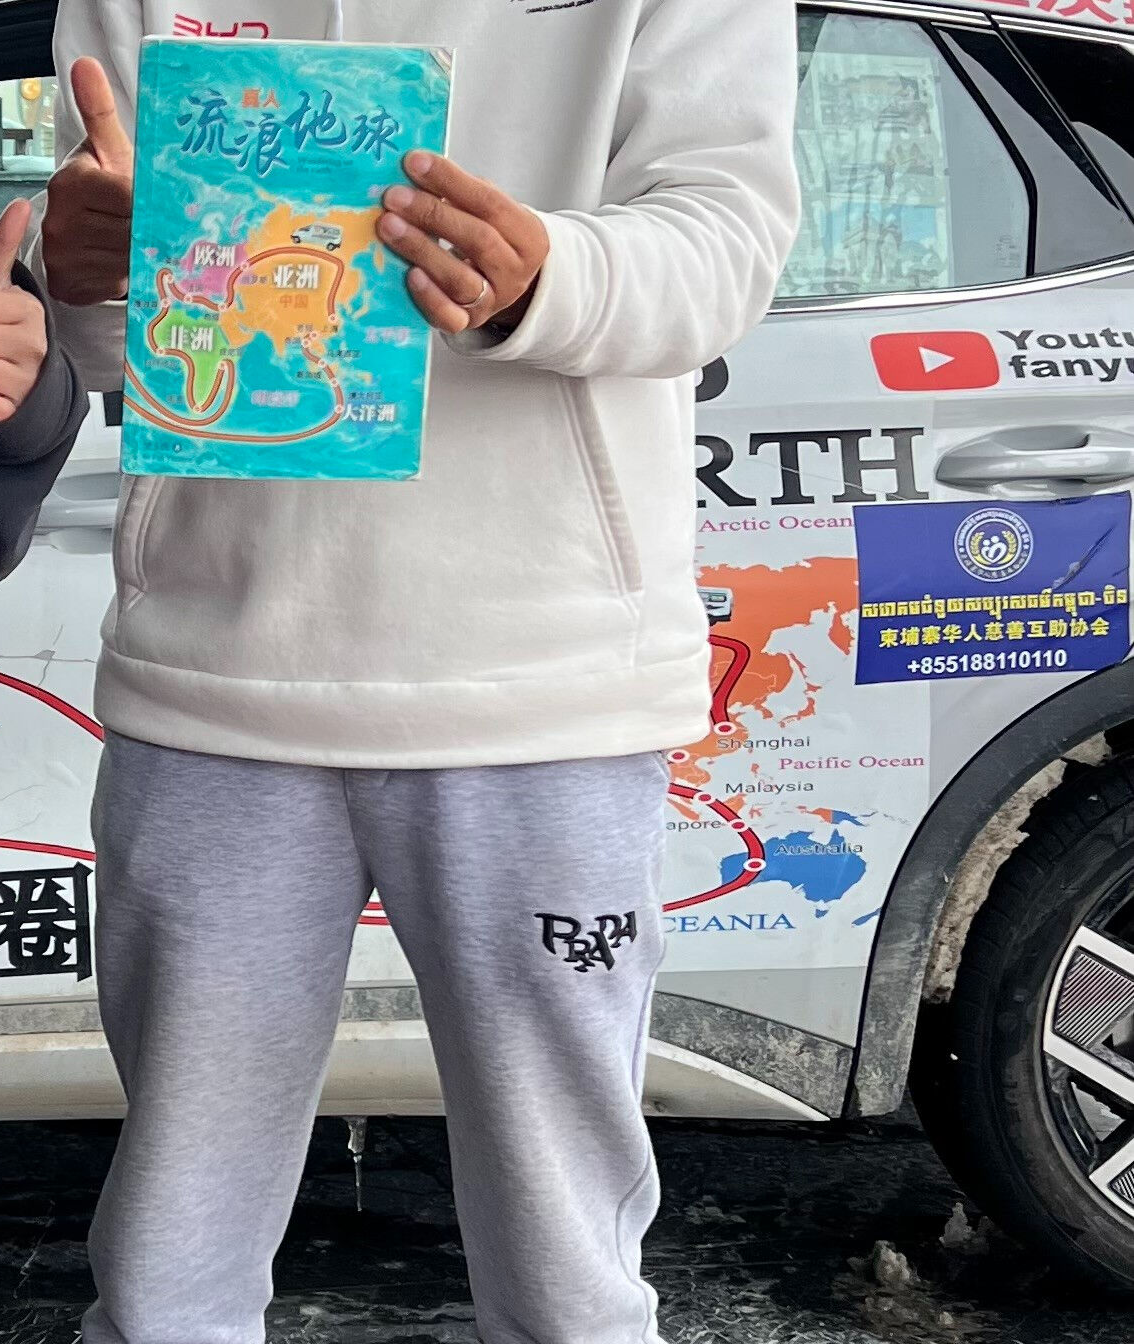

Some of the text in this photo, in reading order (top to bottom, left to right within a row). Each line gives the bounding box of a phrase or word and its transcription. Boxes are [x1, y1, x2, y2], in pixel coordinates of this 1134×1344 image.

[695, 426, 930, 508] RTH
[698, 515, 854, 533] Arctic Ocean
[879, 617, 1110, 648] 柬埔寨华人慈善互助协会
[907, 649, 1068, 675] +855188110110
[717, 736, 811, 751] Shanghai
[778, 755, 925, 770] Pacific Ocean
[725, 781, 814, 794] Malaysia
[666, 819, 722, 833] apore
[774, 842, 864, 855] Australia
